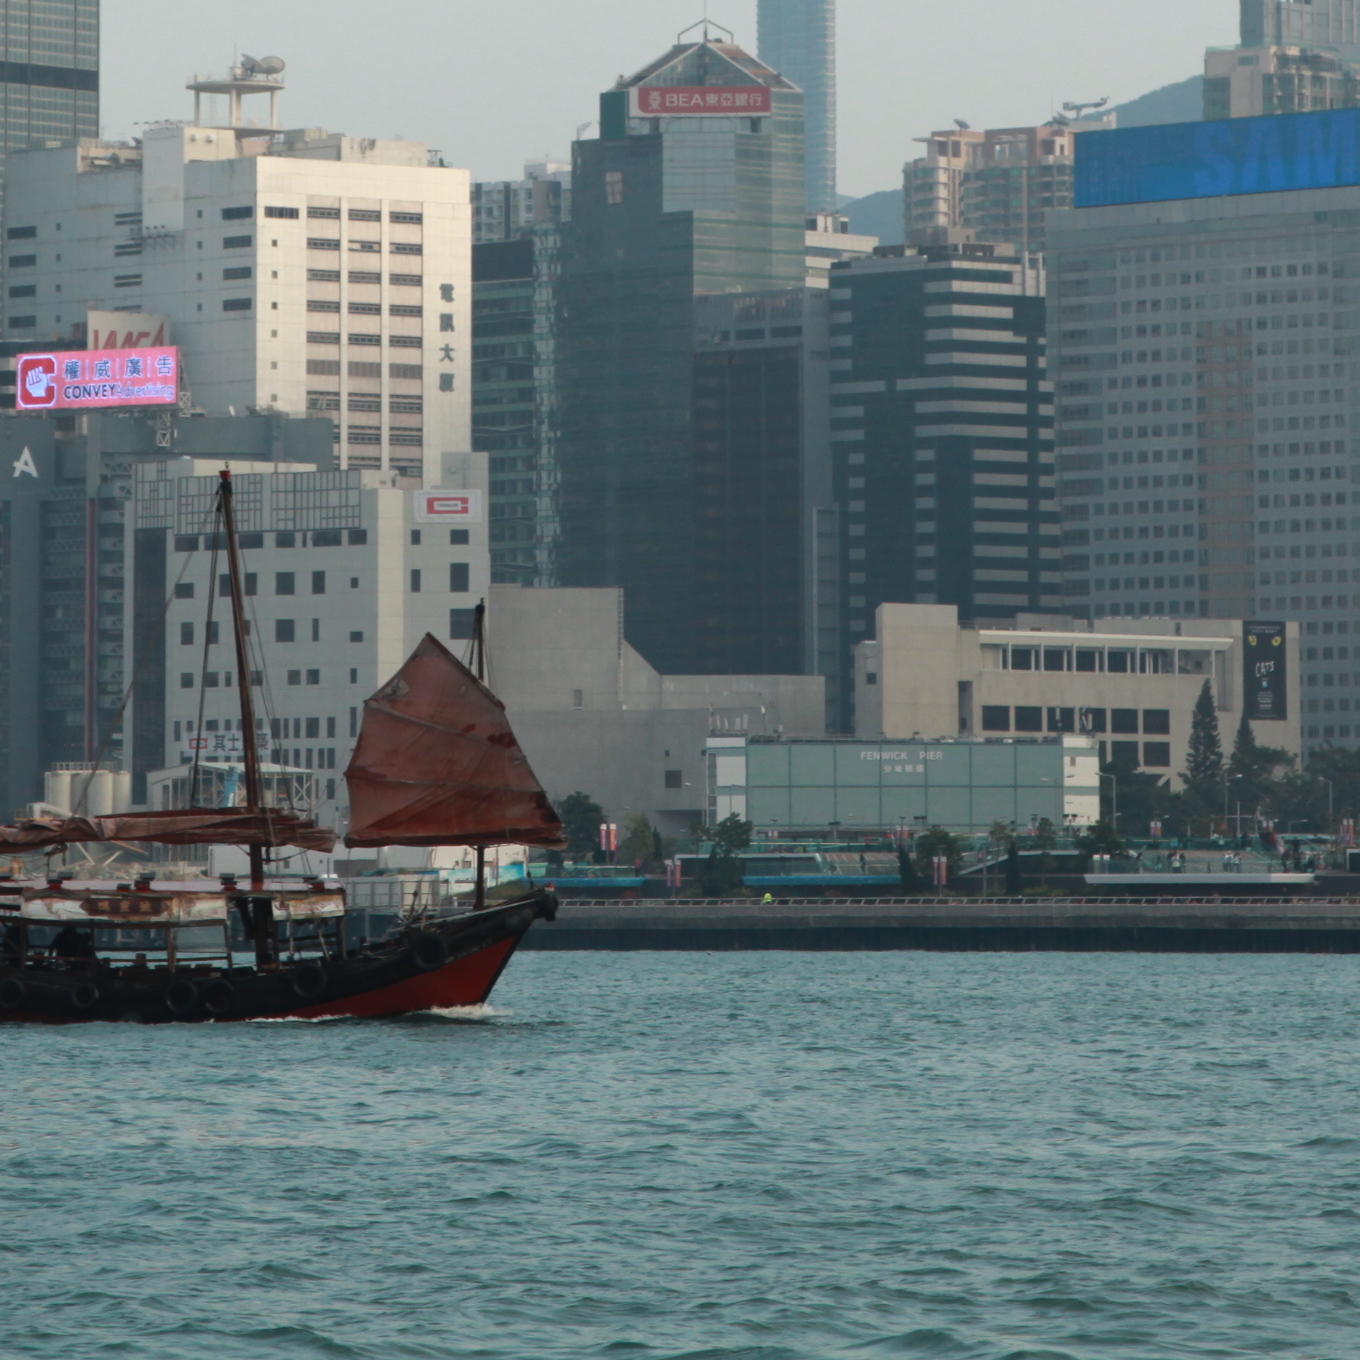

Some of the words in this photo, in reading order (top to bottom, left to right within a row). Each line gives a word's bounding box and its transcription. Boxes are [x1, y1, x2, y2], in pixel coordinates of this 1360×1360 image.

[665, 93, 704, 107] BEA
[705, 93, 762, 107] 東亞銀行
[1255, 661, 1275, 677] CATS
[212, 733, 268, 752] 其士築
[860, 751, 908, 760] FENWICK
[919, 751, 943, 760] PIER
